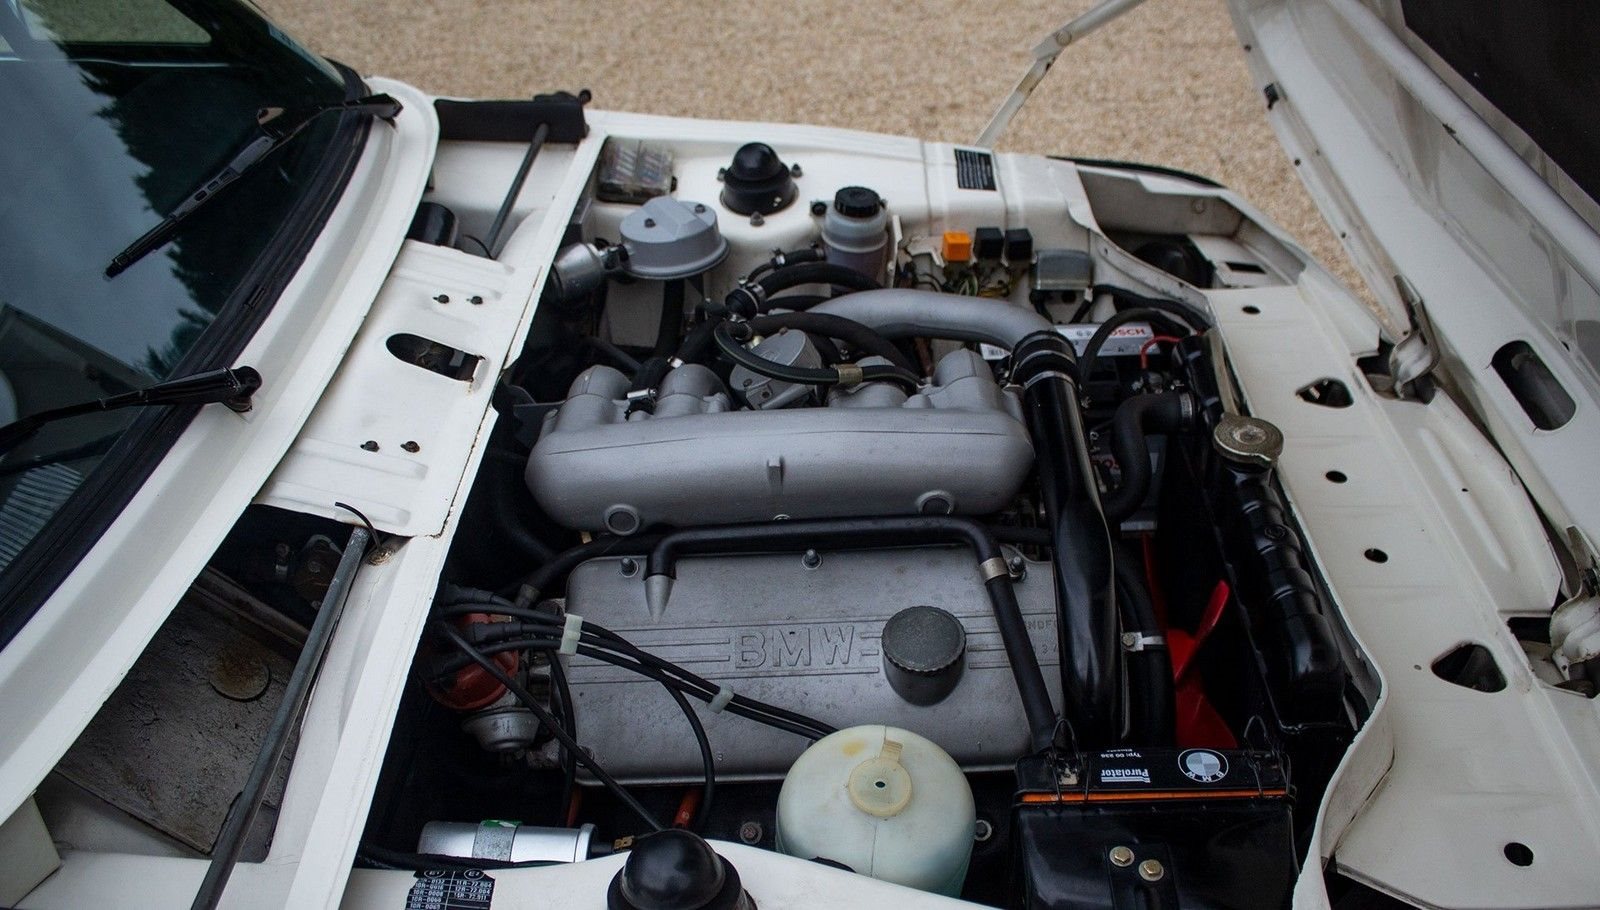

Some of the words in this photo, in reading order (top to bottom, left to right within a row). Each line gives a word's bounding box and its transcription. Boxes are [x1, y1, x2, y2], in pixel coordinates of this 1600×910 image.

[735, 624, 855, 669] BMW
[1100, 768, 1149, 778] Purolator
[1186, 771, 1225, 783] BMW
